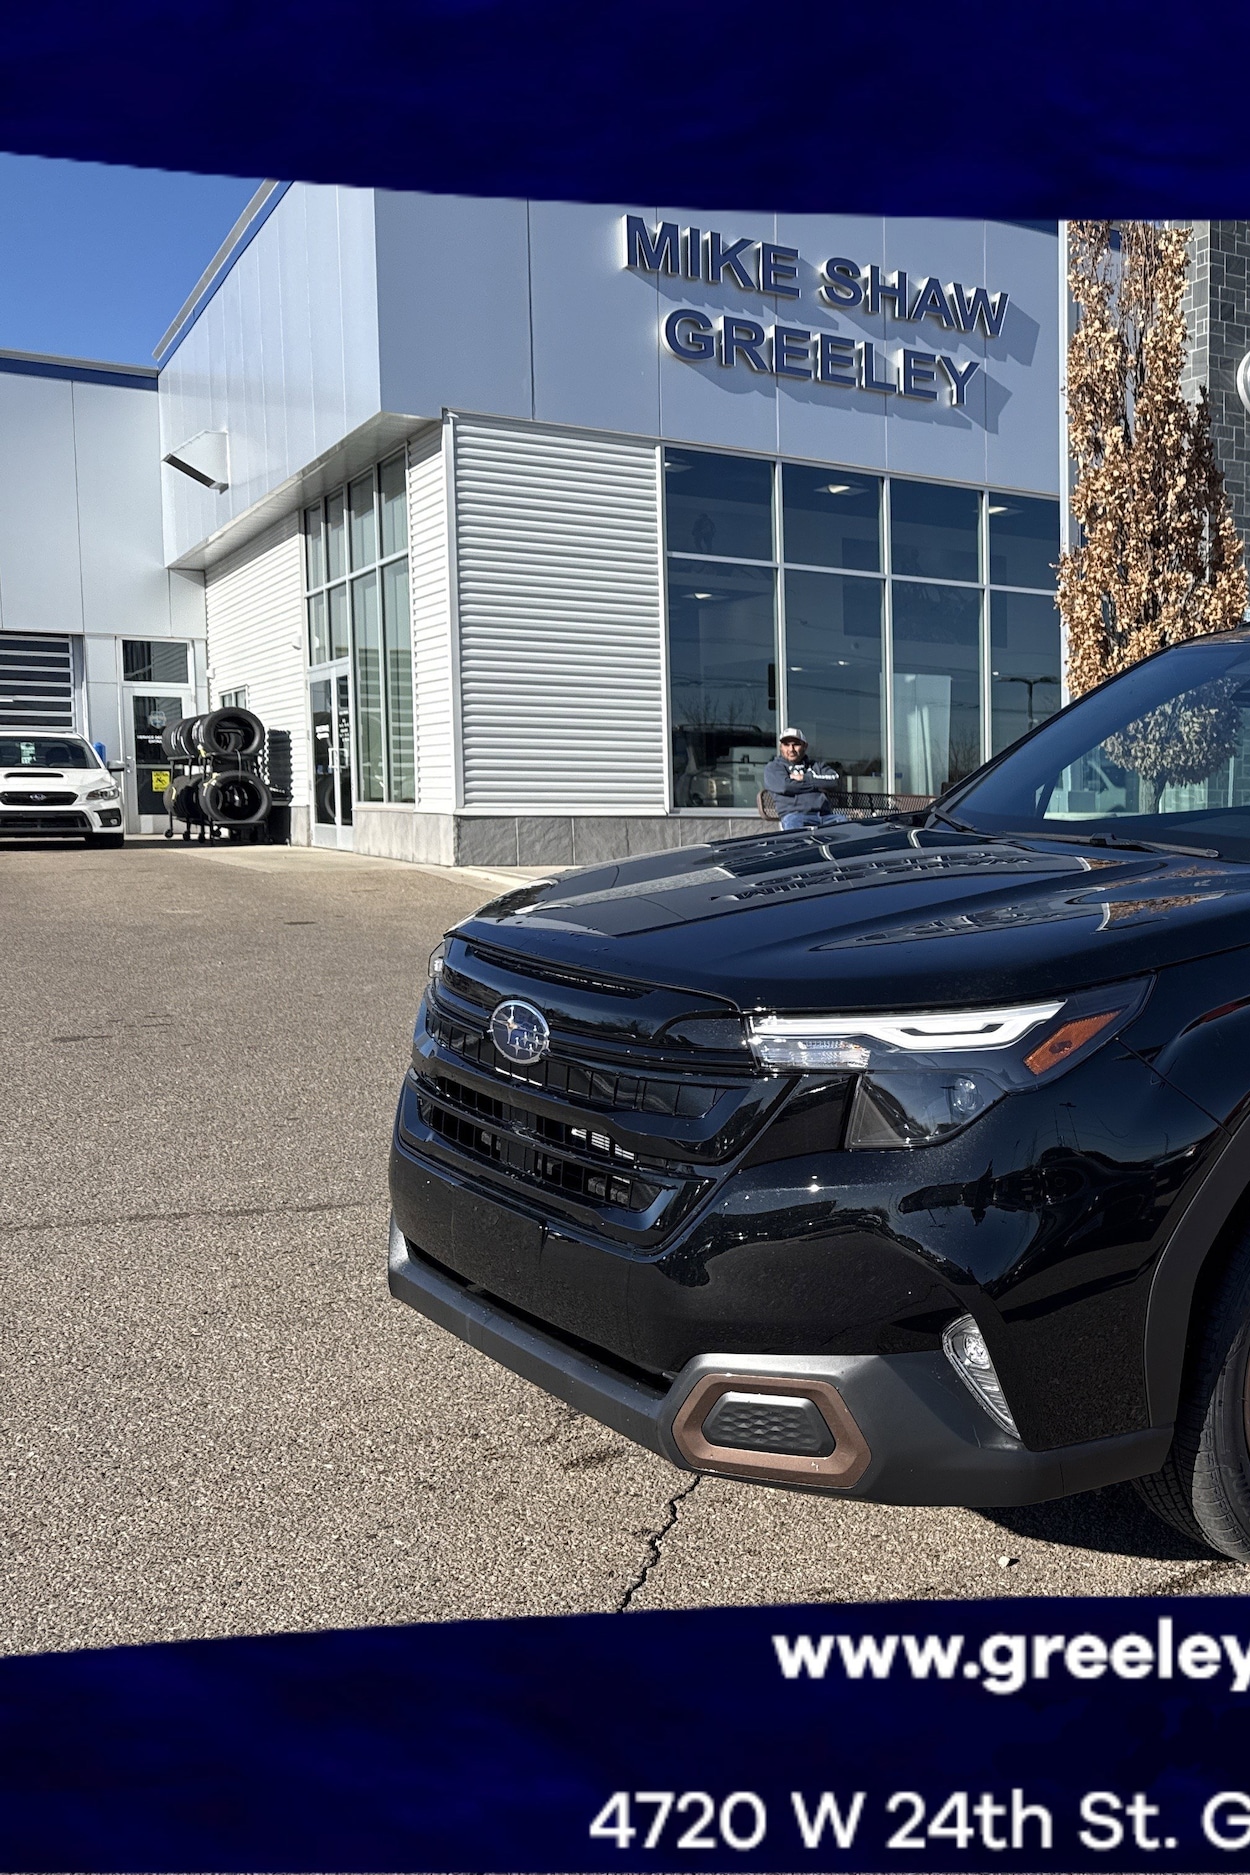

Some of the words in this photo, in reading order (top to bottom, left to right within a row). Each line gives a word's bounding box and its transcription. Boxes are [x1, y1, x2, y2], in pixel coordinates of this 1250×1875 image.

[621, 213, 801, 299] MIKE
[818, 256, 1010, 338] SHAW
[662, 308, 981, 407] GREELEY
